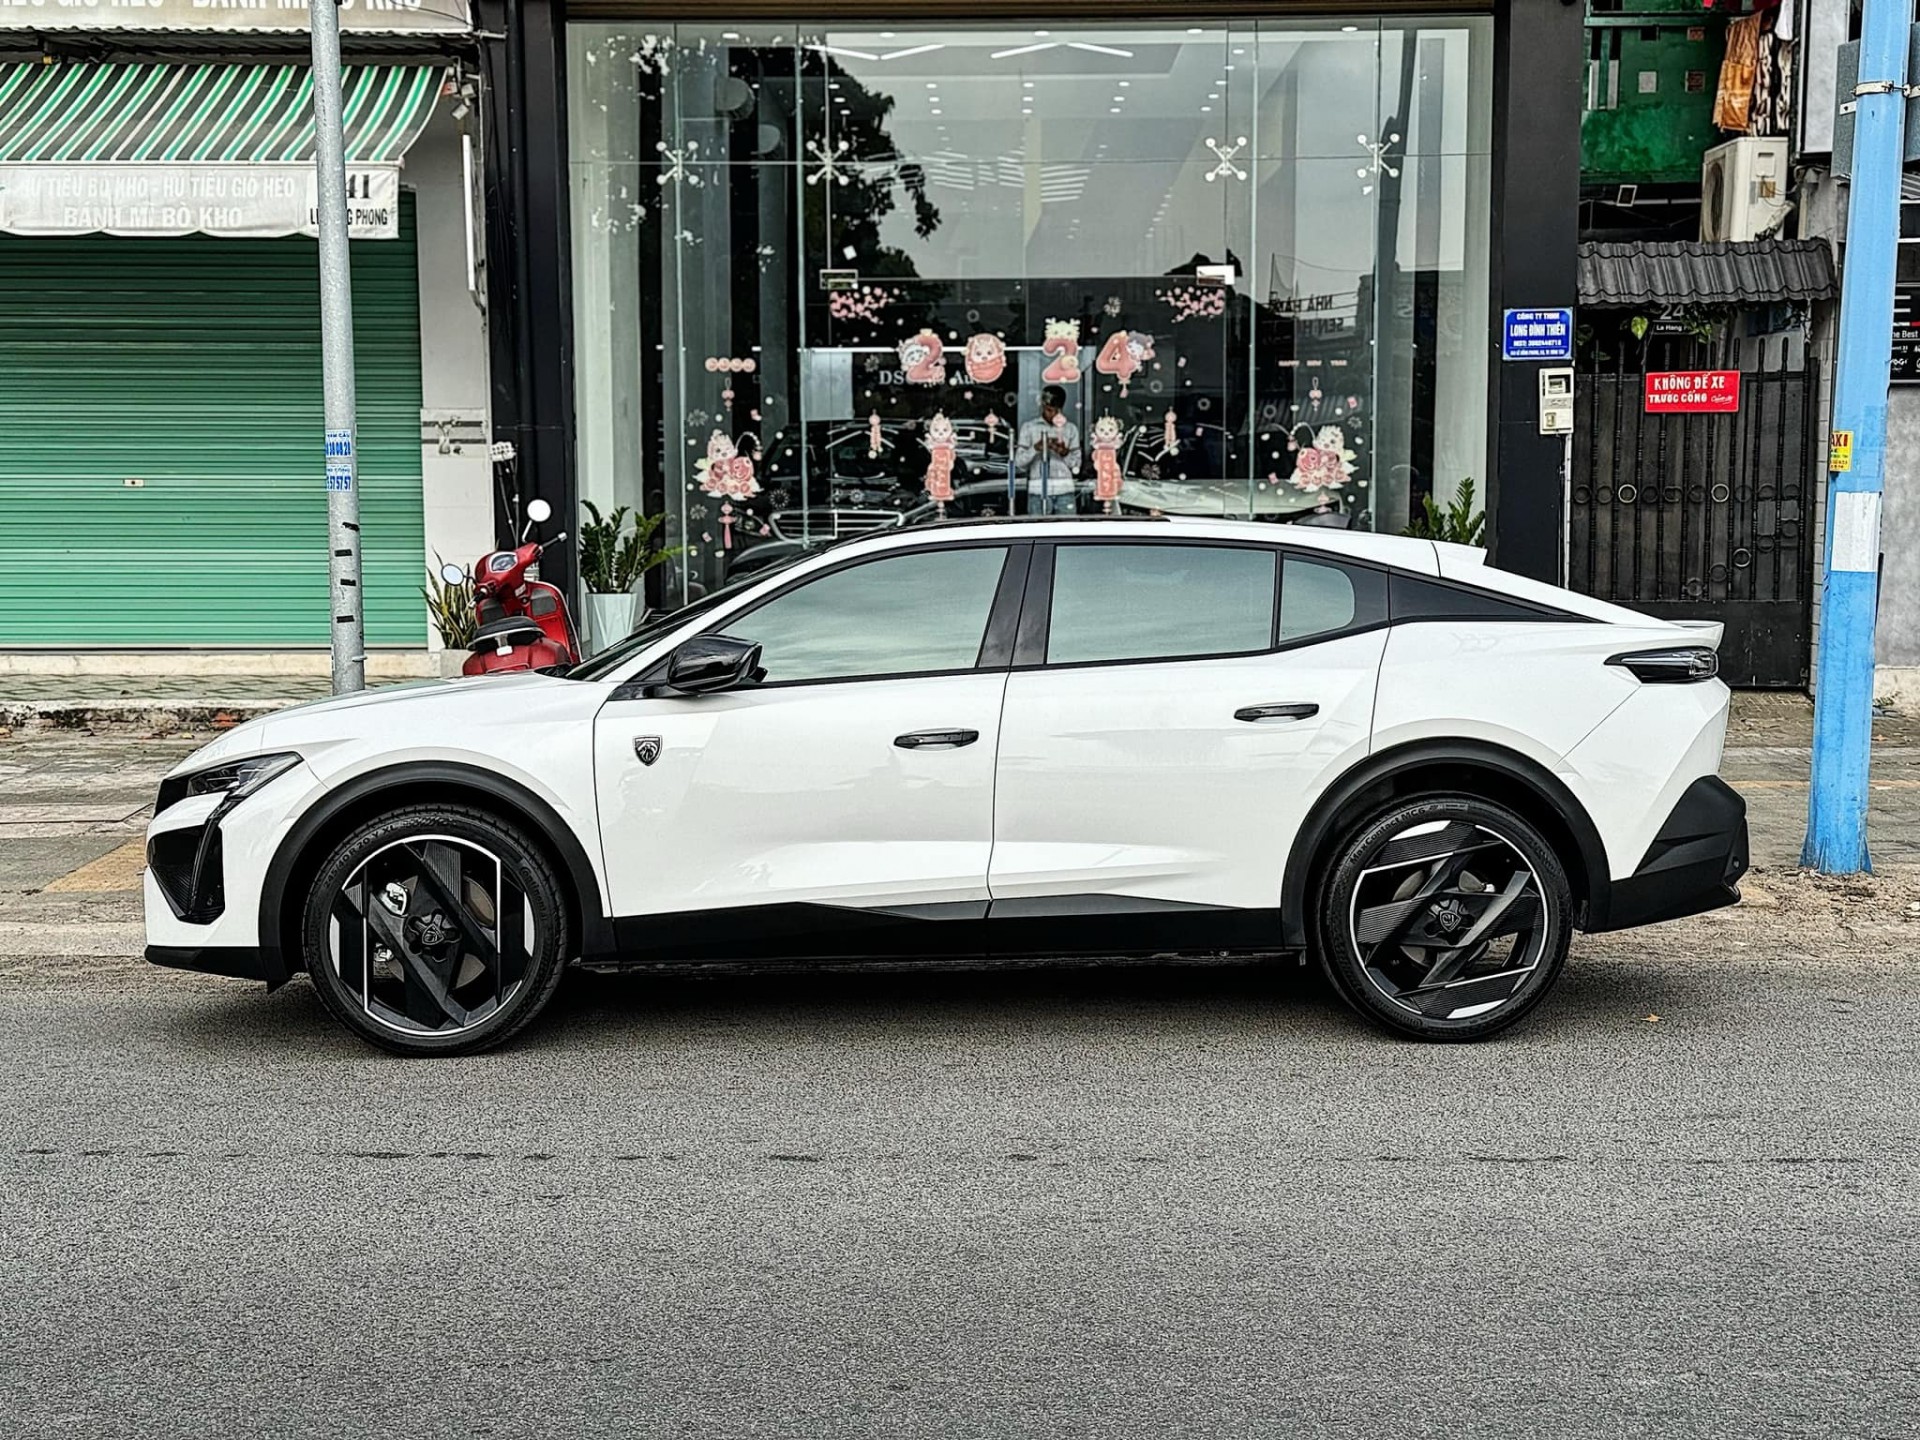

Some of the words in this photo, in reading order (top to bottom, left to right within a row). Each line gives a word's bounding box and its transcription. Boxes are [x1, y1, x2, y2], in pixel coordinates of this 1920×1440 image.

[264, 176, 294, 198] HEO
[161, 202, 191, 227] BÒ
[199, 207, 242, 228] KHO
[355, 208, 387, 225] PHONG
[1535, 312, 1542, 320] TY
[1510, 324, 1528, 337] LONG
[1654, 374, 1691, 391] KHÔNG
[1710, 375, 1725, 389] XE
[1830, 434, 1848, 447] AXI
[1350, 817, 1401, 864] MaxContact
